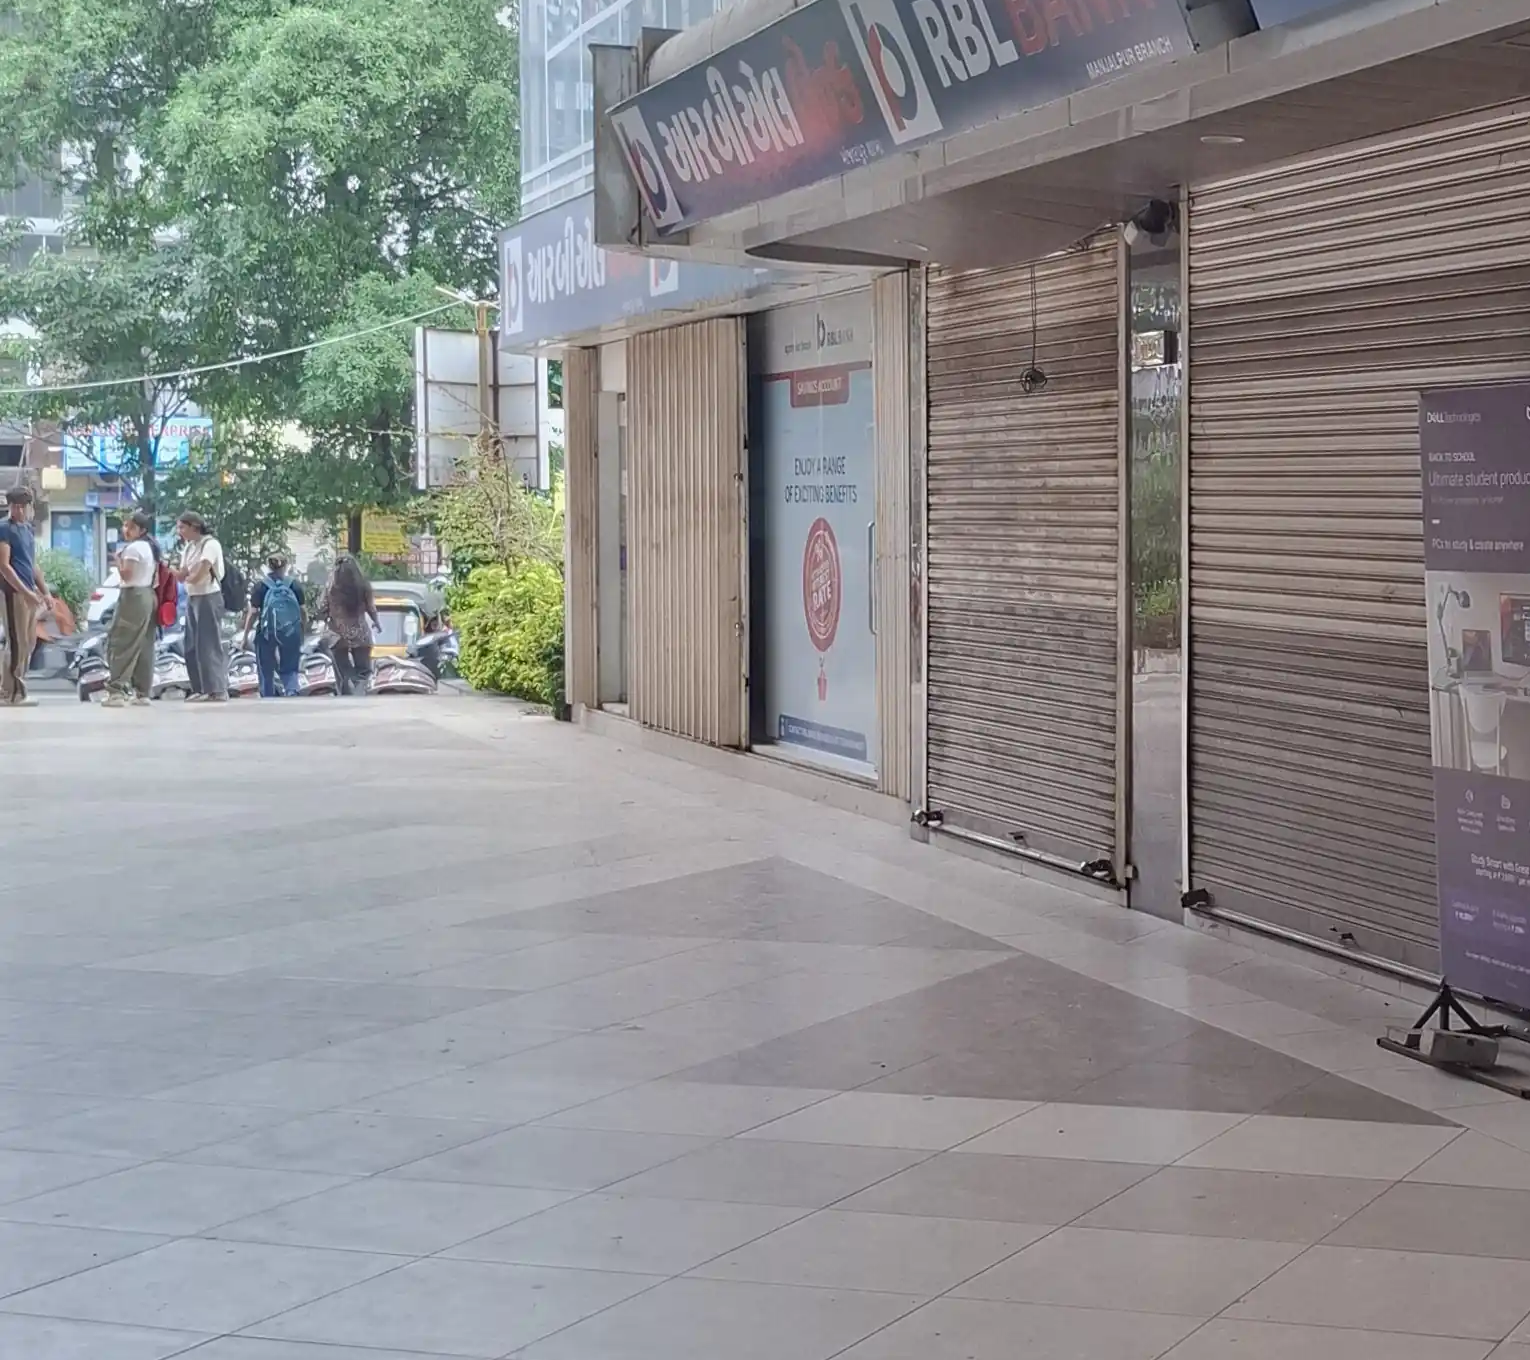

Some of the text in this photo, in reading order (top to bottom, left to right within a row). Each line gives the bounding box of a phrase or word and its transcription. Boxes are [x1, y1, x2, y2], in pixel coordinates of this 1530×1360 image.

[1085, 35, 1174, 81] MANJALPUR BRANCH
[822, 456, 846, 476] RANGE
[1428, 470, 1464, 487] Ultimate
[1465, 470, 1498, 486] student
[826, 484, 858, 503] BENEFITS
